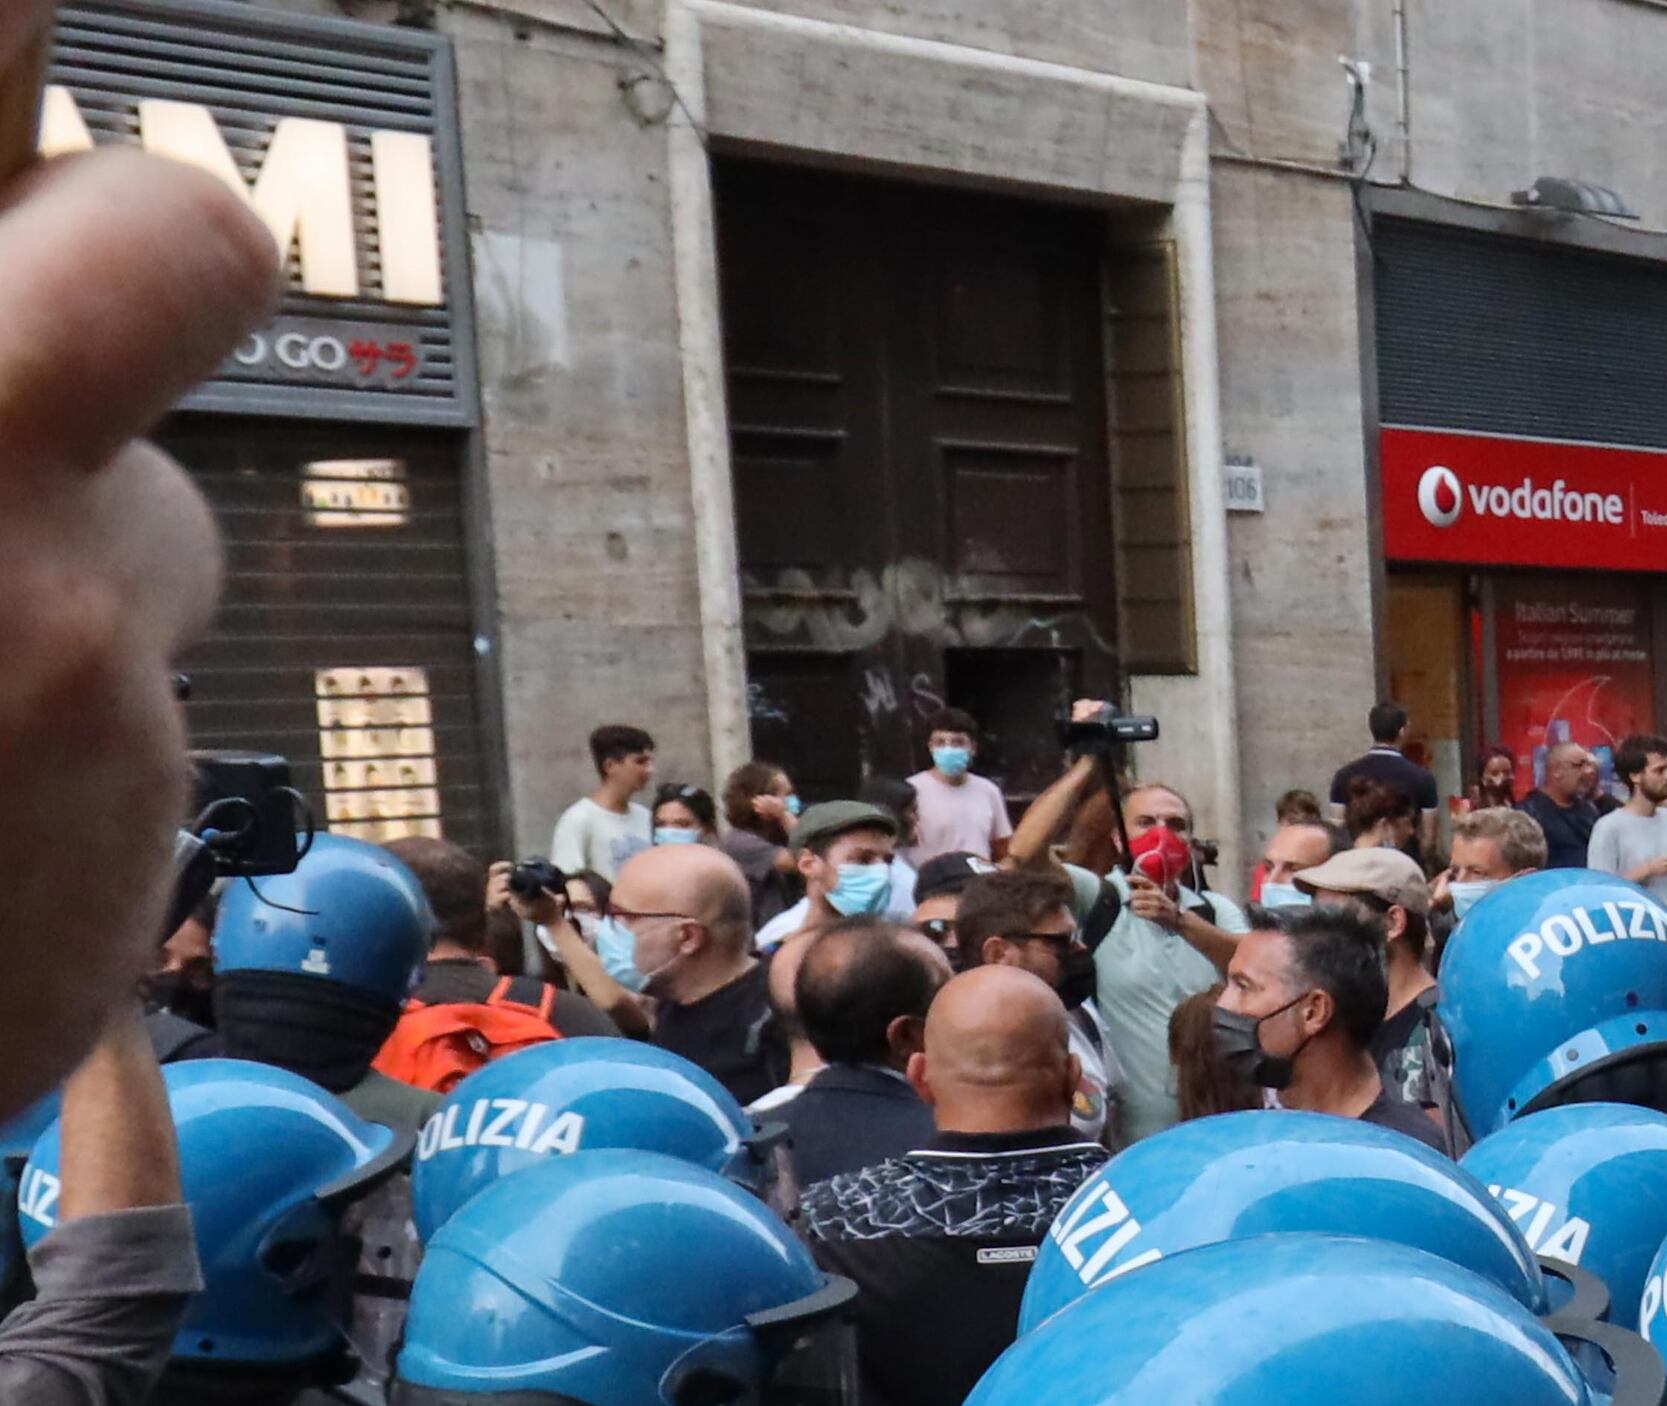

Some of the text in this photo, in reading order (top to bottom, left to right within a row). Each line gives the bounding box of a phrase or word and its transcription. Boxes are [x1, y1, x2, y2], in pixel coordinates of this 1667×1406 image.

[38, 85, 443, 304] MI
[275, 333, 345, 371] GO
[1468, 477, 1624, 524] vodafone
[417, 1098, 585, 1160] OLIZIA
